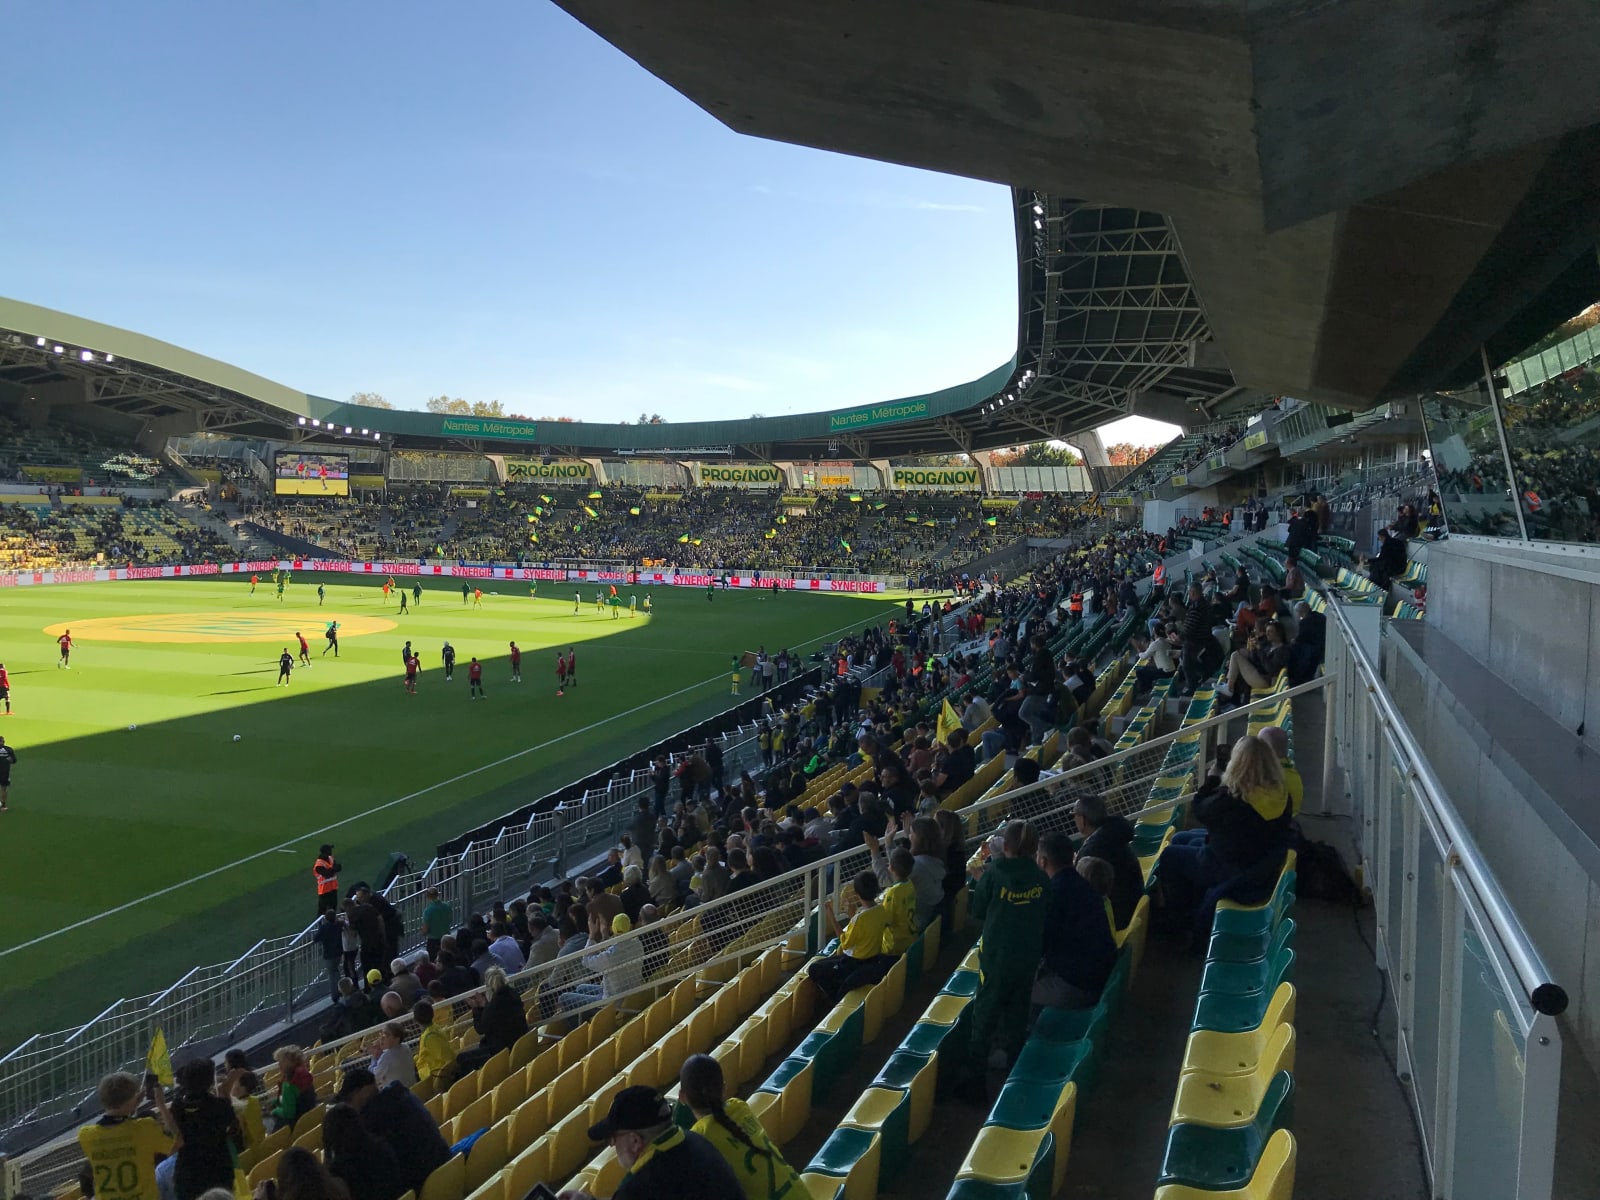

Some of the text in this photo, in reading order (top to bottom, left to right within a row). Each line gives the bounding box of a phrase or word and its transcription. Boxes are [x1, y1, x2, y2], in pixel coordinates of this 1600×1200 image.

[831, 402, 926, 426] Nantes Métropole
[443, 419, 534, 436] Nantes Métropole
[126, 567, 164, 579] SYNERGIE
[313, 562, 352, 573] SYNERGIE
[381, 564, 421, 575] SYNERGIE
[451, 566, 492, 577] SYNERGIE
[54, 570, 97, 584] SYNERGIE
[523, 569, 566, 580] SYNERGIE
[831, 580, 877, 592] SYNERGIE
[95, 1161, 138, 1193] 20
